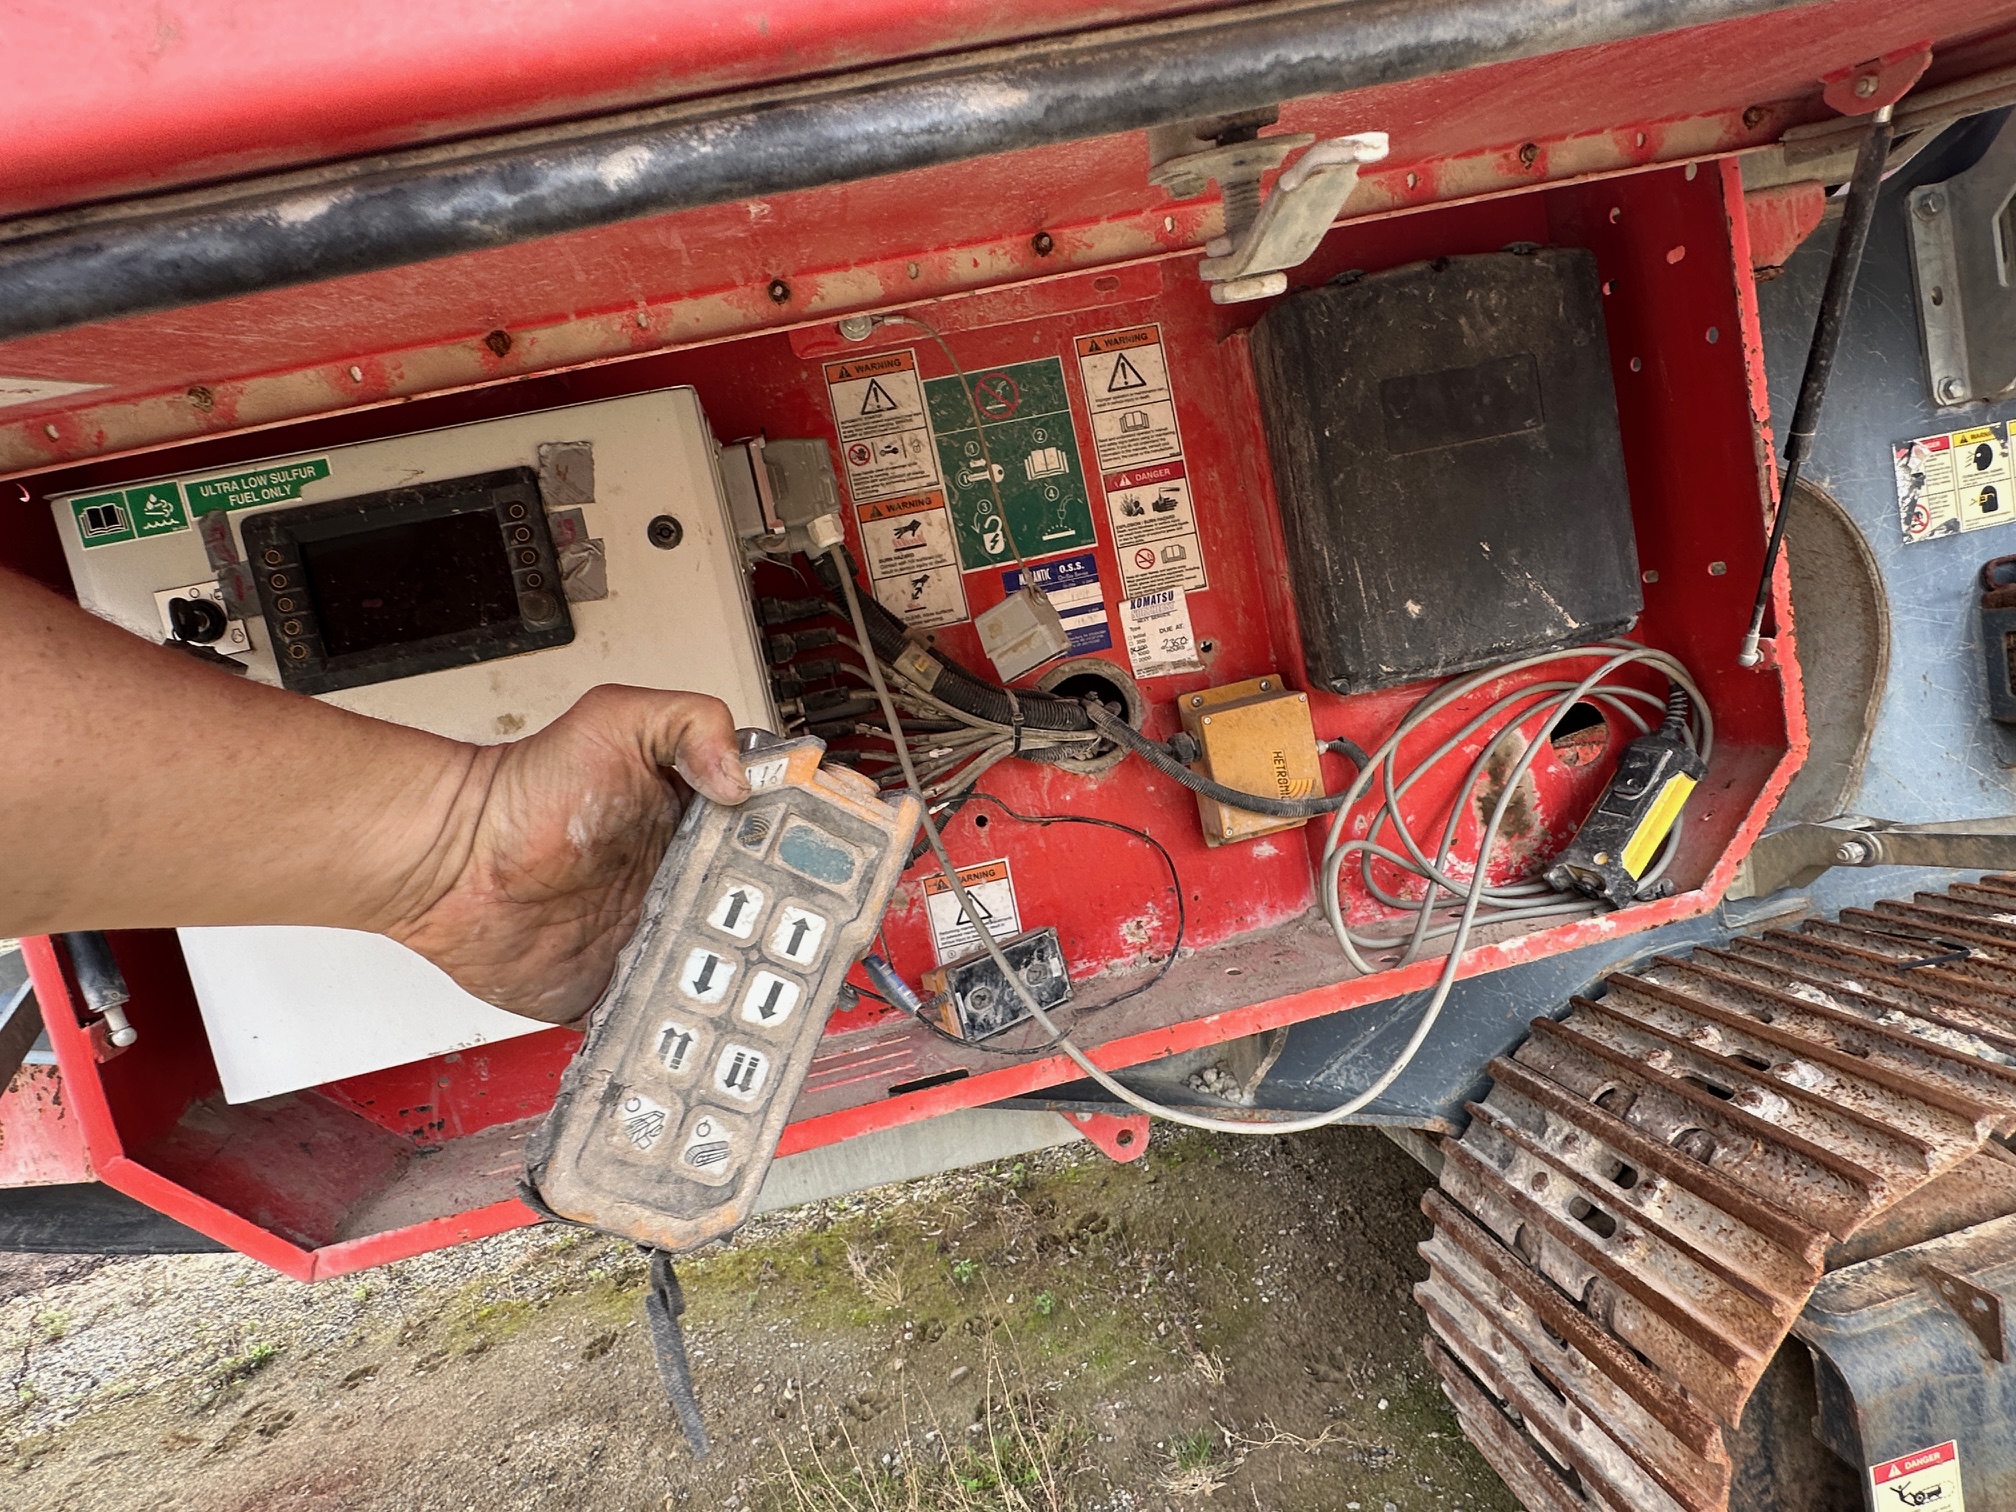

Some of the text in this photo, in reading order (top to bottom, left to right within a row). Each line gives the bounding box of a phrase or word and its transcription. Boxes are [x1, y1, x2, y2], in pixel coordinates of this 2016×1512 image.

[1103, 333, 1148, 347] WARNING
[855, 358, 901, 374] WARNING
[199, 465, 317, 497] ULTRA LOW SULFUR
[1135, 467, 1171, 482] DANGER
[228, 484, 292, 506] FUEL ONLY
[886, 496, 932, 513] WARNING
[1058, 561, 1085, 573] O.S.S.
[1130, 590, 1174, 609] KOMATSU
[1158, 625, 1173, 633] DUE
[958, 869, 996, 883] ARNING
[1905, 1452, 1940, 1470] DANGER
